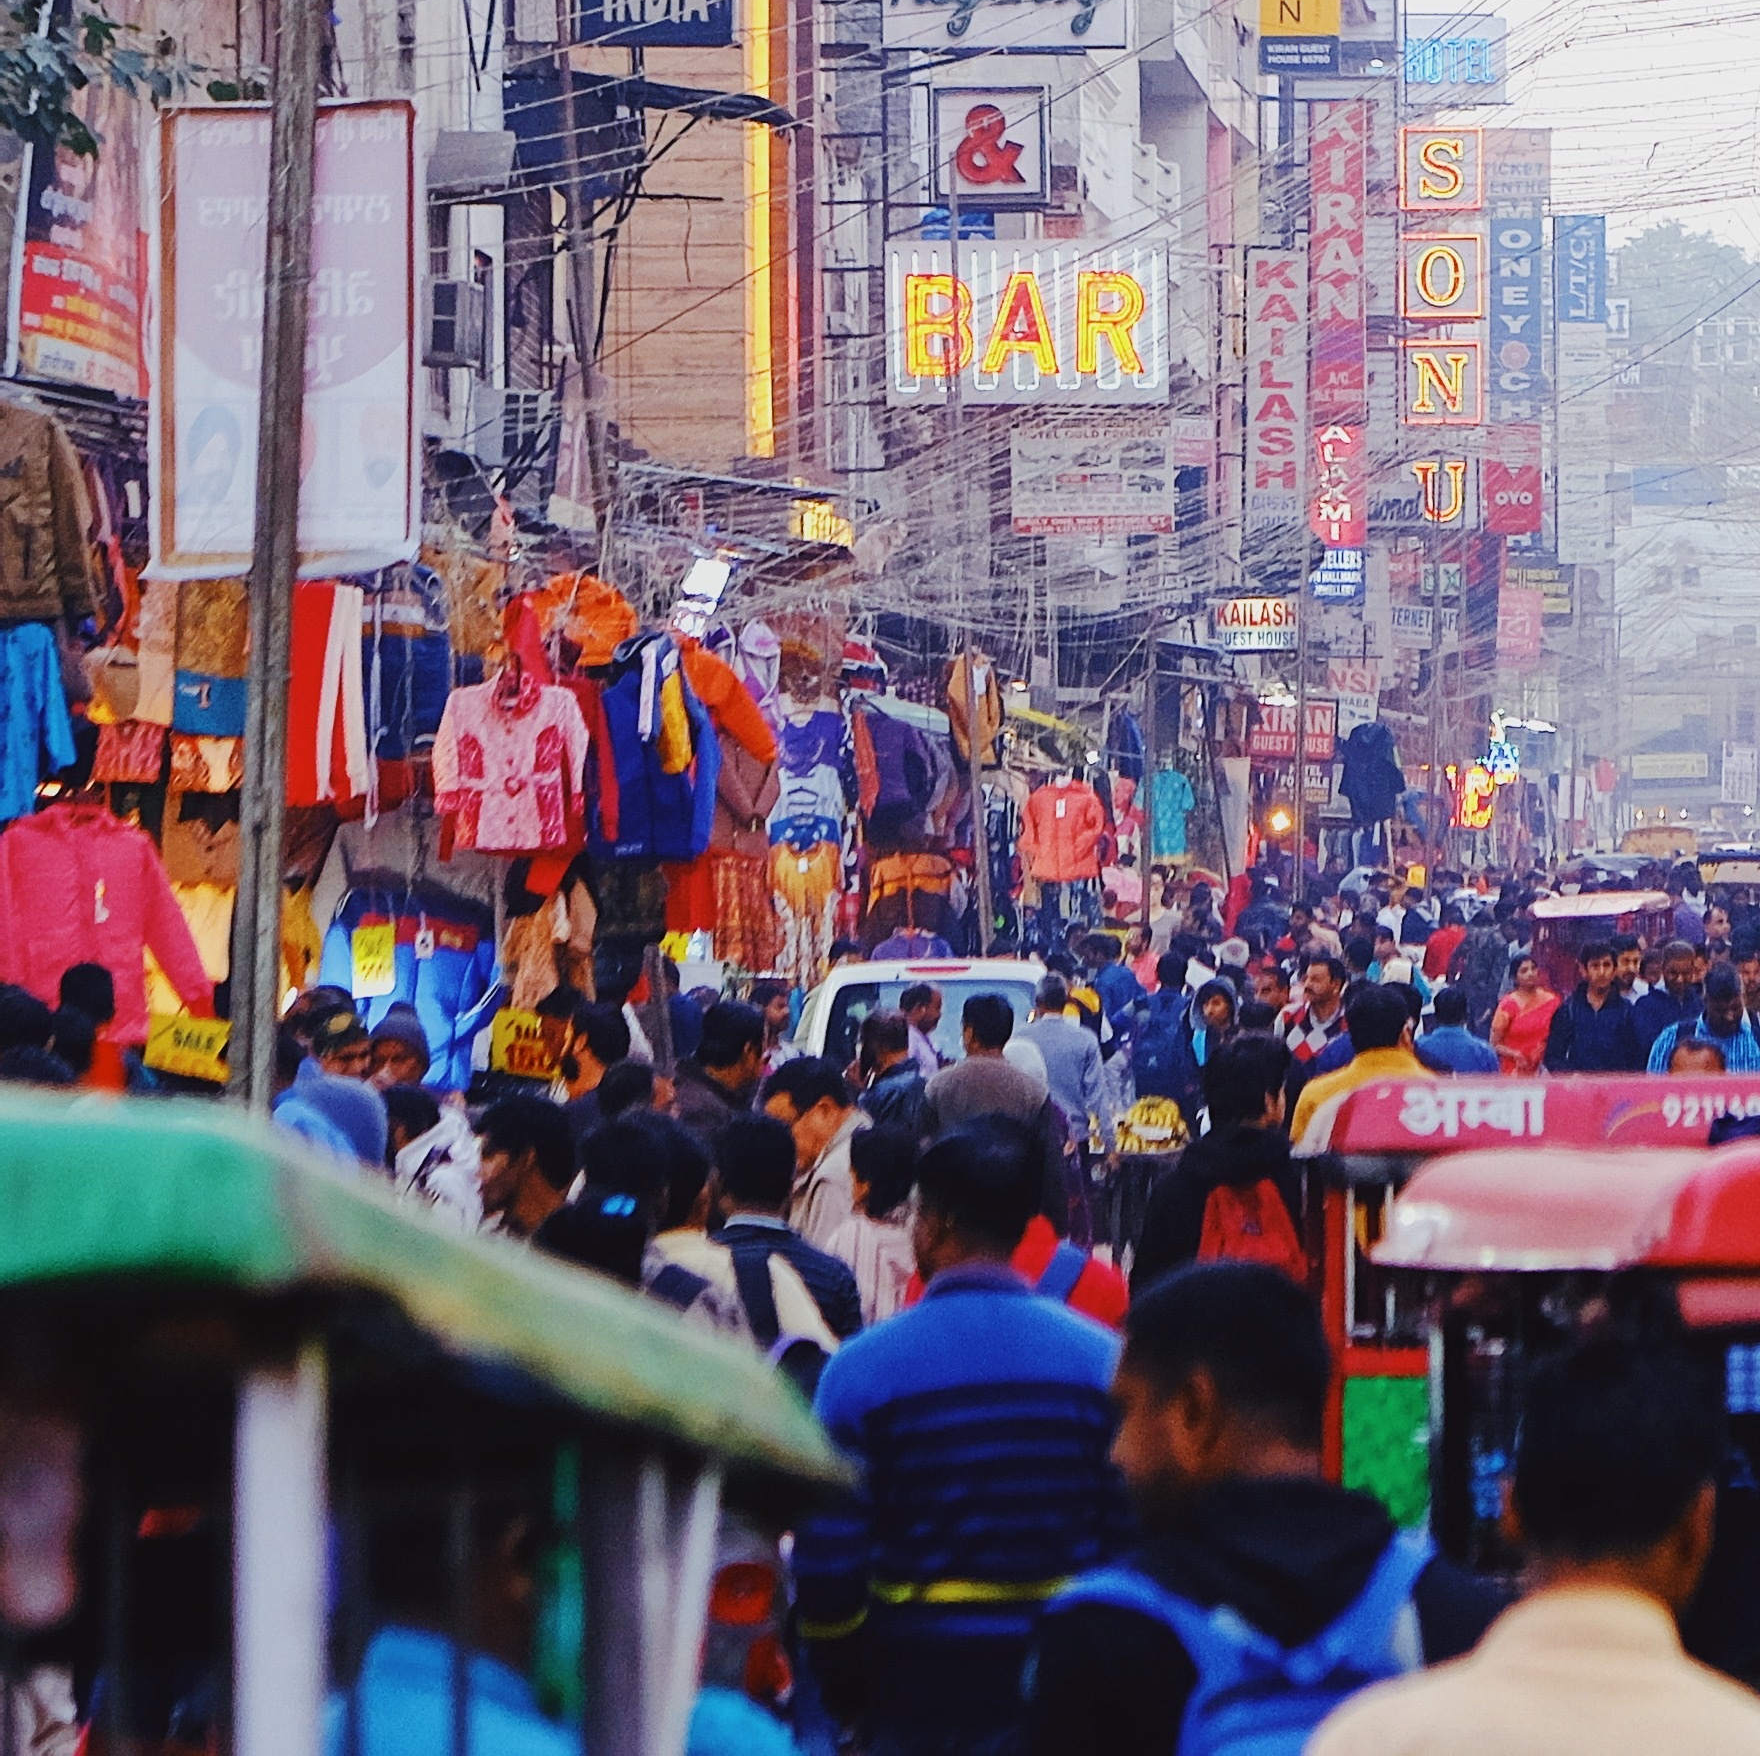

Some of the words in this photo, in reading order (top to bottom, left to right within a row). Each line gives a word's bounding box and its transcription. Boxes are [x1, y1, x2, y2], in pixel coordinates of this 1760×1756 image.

[1405, 37, 1497, 85] HOTEL
[955, 103, 1027, 184] &
[1313, 101, 1362, 321] KIRAN
[904, 270, 1146, 379] BAR
[1412, 136, 1467, 524] SONU
[1254, 259, 1298, 489] KAILASH
[1494, 491, 1533, 506] OYO
[1217, 601, 1297, 626] KAILASH
[1217, 631, 1252, 646] UEST
[1257, 631, 1296, 647] HOUSE
[1253, 735, 1289, 751] GUEST
